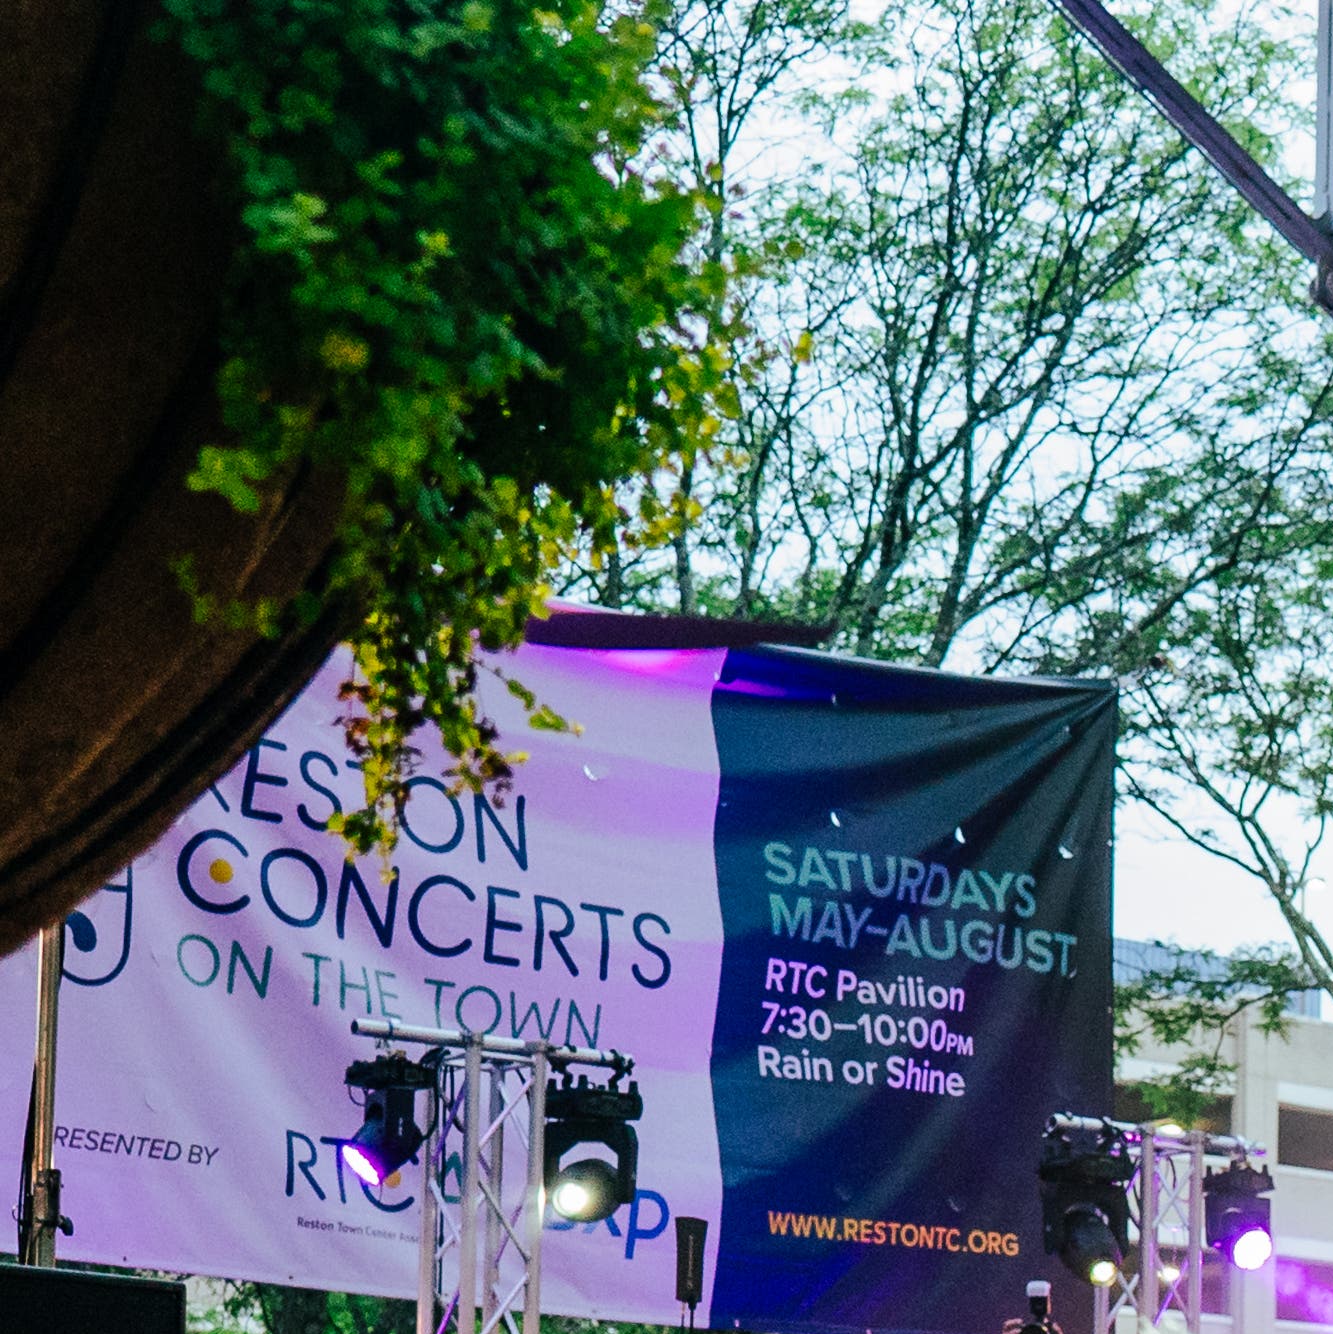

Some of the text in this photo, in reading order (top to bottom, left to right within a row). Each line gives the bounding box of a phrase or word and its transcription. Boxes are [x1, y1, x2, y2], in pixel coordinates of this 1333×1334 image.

[211, 737, 528, 871] ESON
[764, 842, 1037, 918] SATURDAYS
[177, 828, 672, 990] CONCERTS
[177, 933, 602, 1049] ON THE TOWN
[765, 957, 966, 1013] RTC Pavilion
[757, 1045, 966, 1097] Rain or Shine
[53, 1125, 220, 1167] RESENTED BY
[297, 1216, 335, 1232] Reston
[338, 1221, 363, 1235] Town
[767, 1210, 1020, 1257] WWW.RESTONTC.ORG
